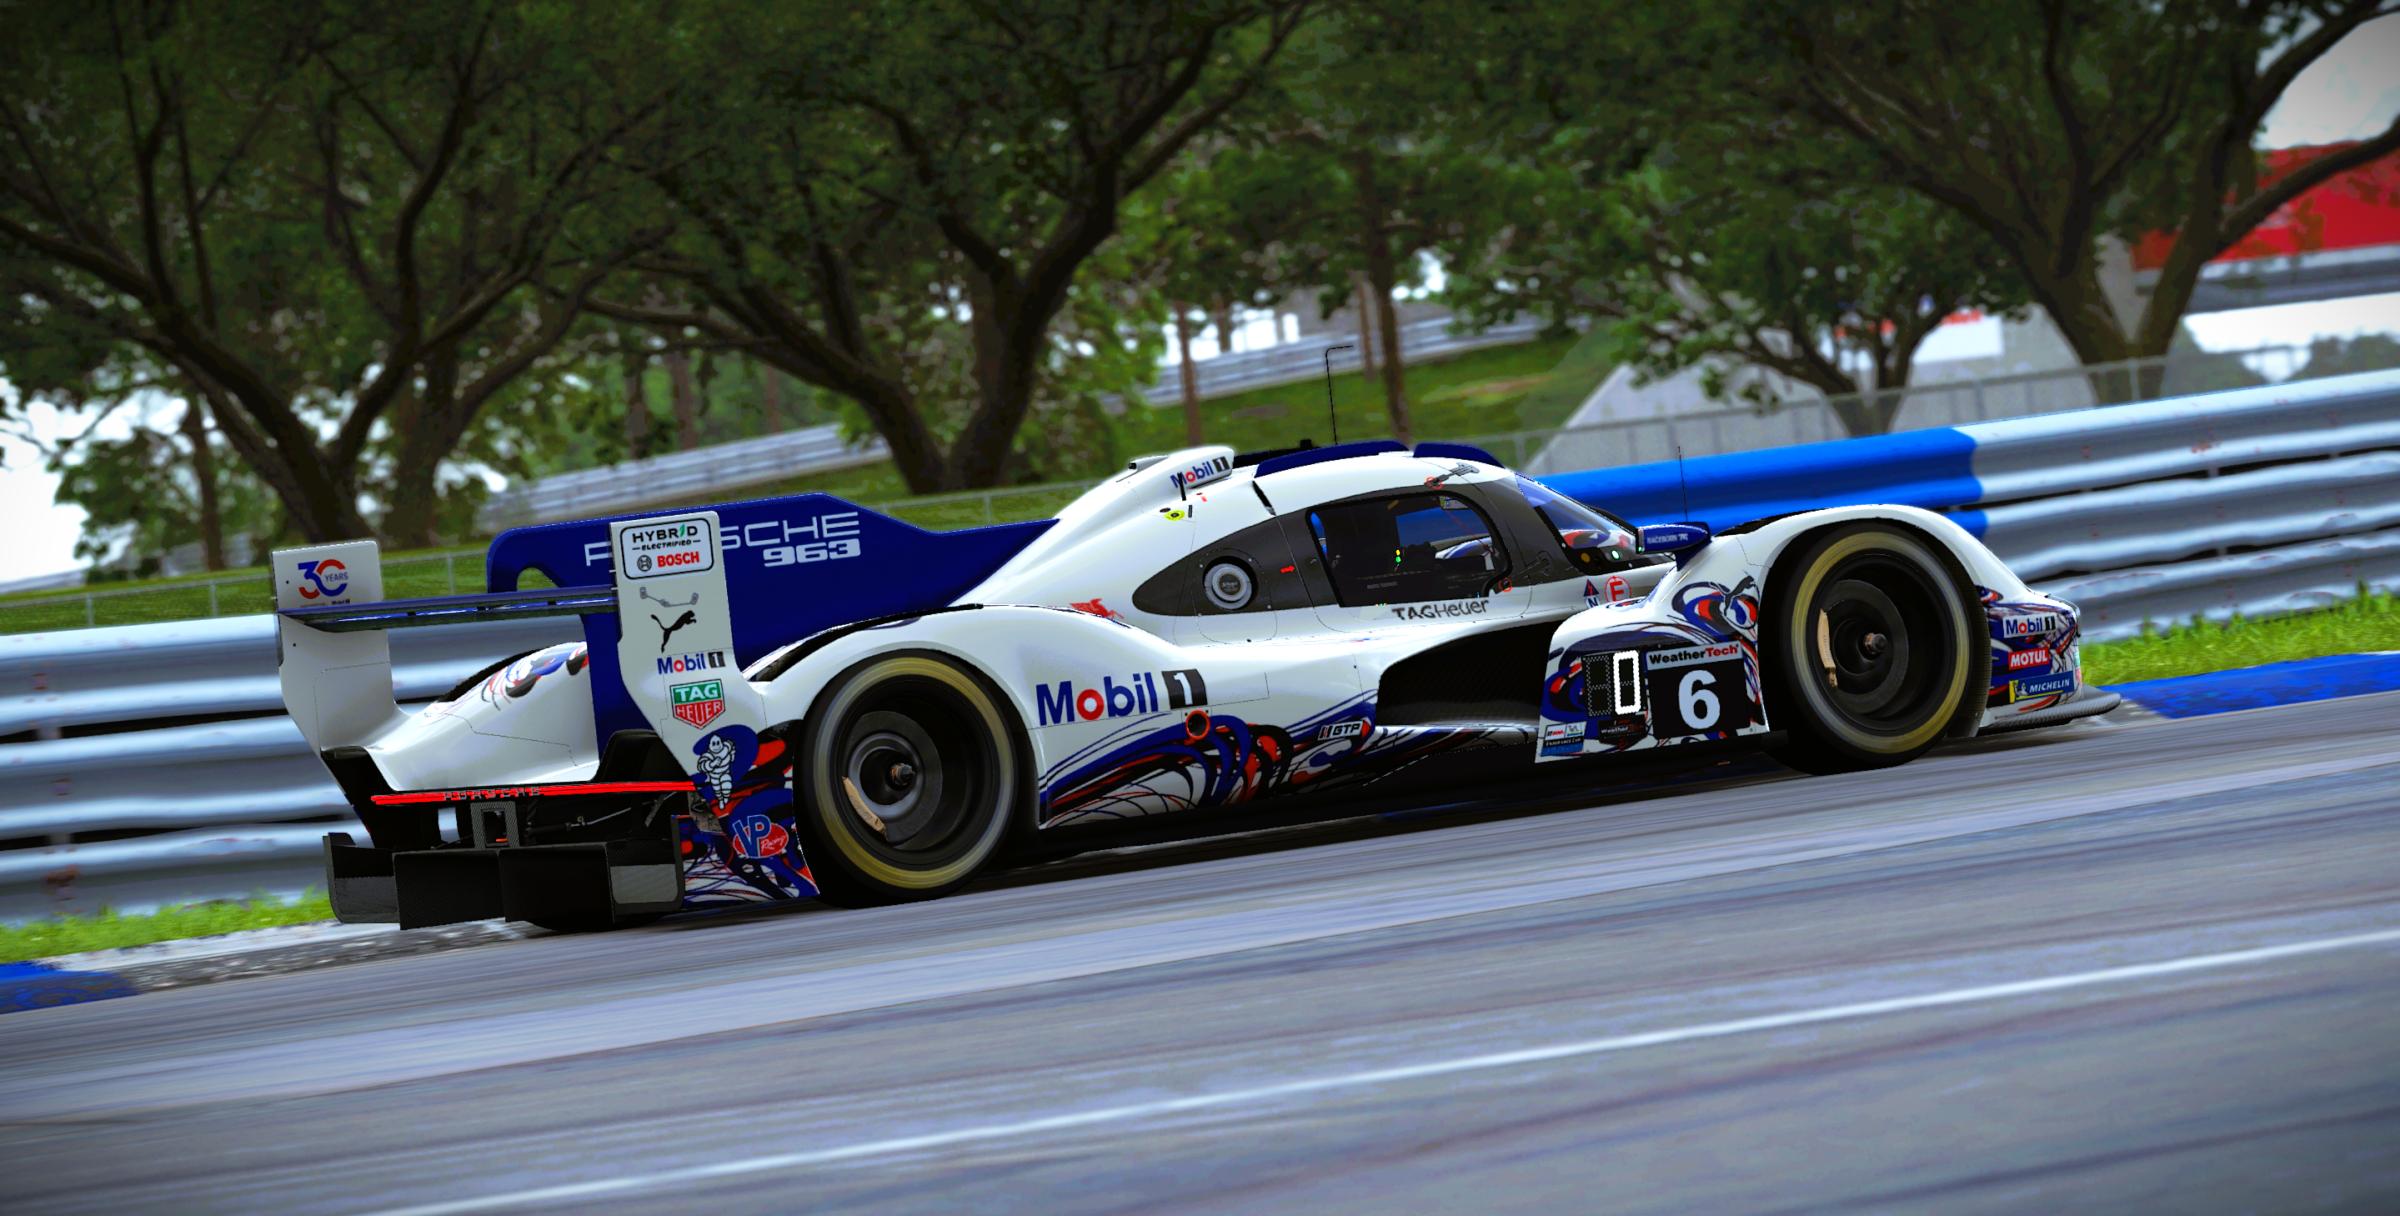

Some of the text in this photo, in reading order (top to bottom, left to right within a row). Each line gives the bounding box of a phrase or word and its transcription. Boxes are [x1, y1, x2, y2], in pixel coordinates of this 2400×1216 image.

[1170, 461, 1214, 488] Mobil
[584, 511, 861, 566] PSCHE
[632, 525, 698, 543] HYBRID
[641, 539, 692, 551] ELECTRIFIED
[763, 538, 861, 567] 963
[657, 551, 700, 568] BOSCH
[298, 559, 347, 599] 30
[324, 571, 348, 582] YEARS
[1610, 580, 1625, 602] F
[1391, 600, 1489, 620] TAGHeuer
[2005, 617, 2043, 635] Mobil
[657, 653, 706, 675] Mobil
[1649, 643, 1739, 664] WeatherTech
[2010, 650, 2048, 668] MOTUL
[675, 683, 719, 702] TAG
[2029, 679, 2070, 693] MICHELIN
[1036, 672, 1158, 726] Mobil
[1678, 669, 1720, 729] 6
[676, 701, 721, 724] HEUER
[1332, 723, 1361, 736] GTP
[732, 814, 771, 859] VP
